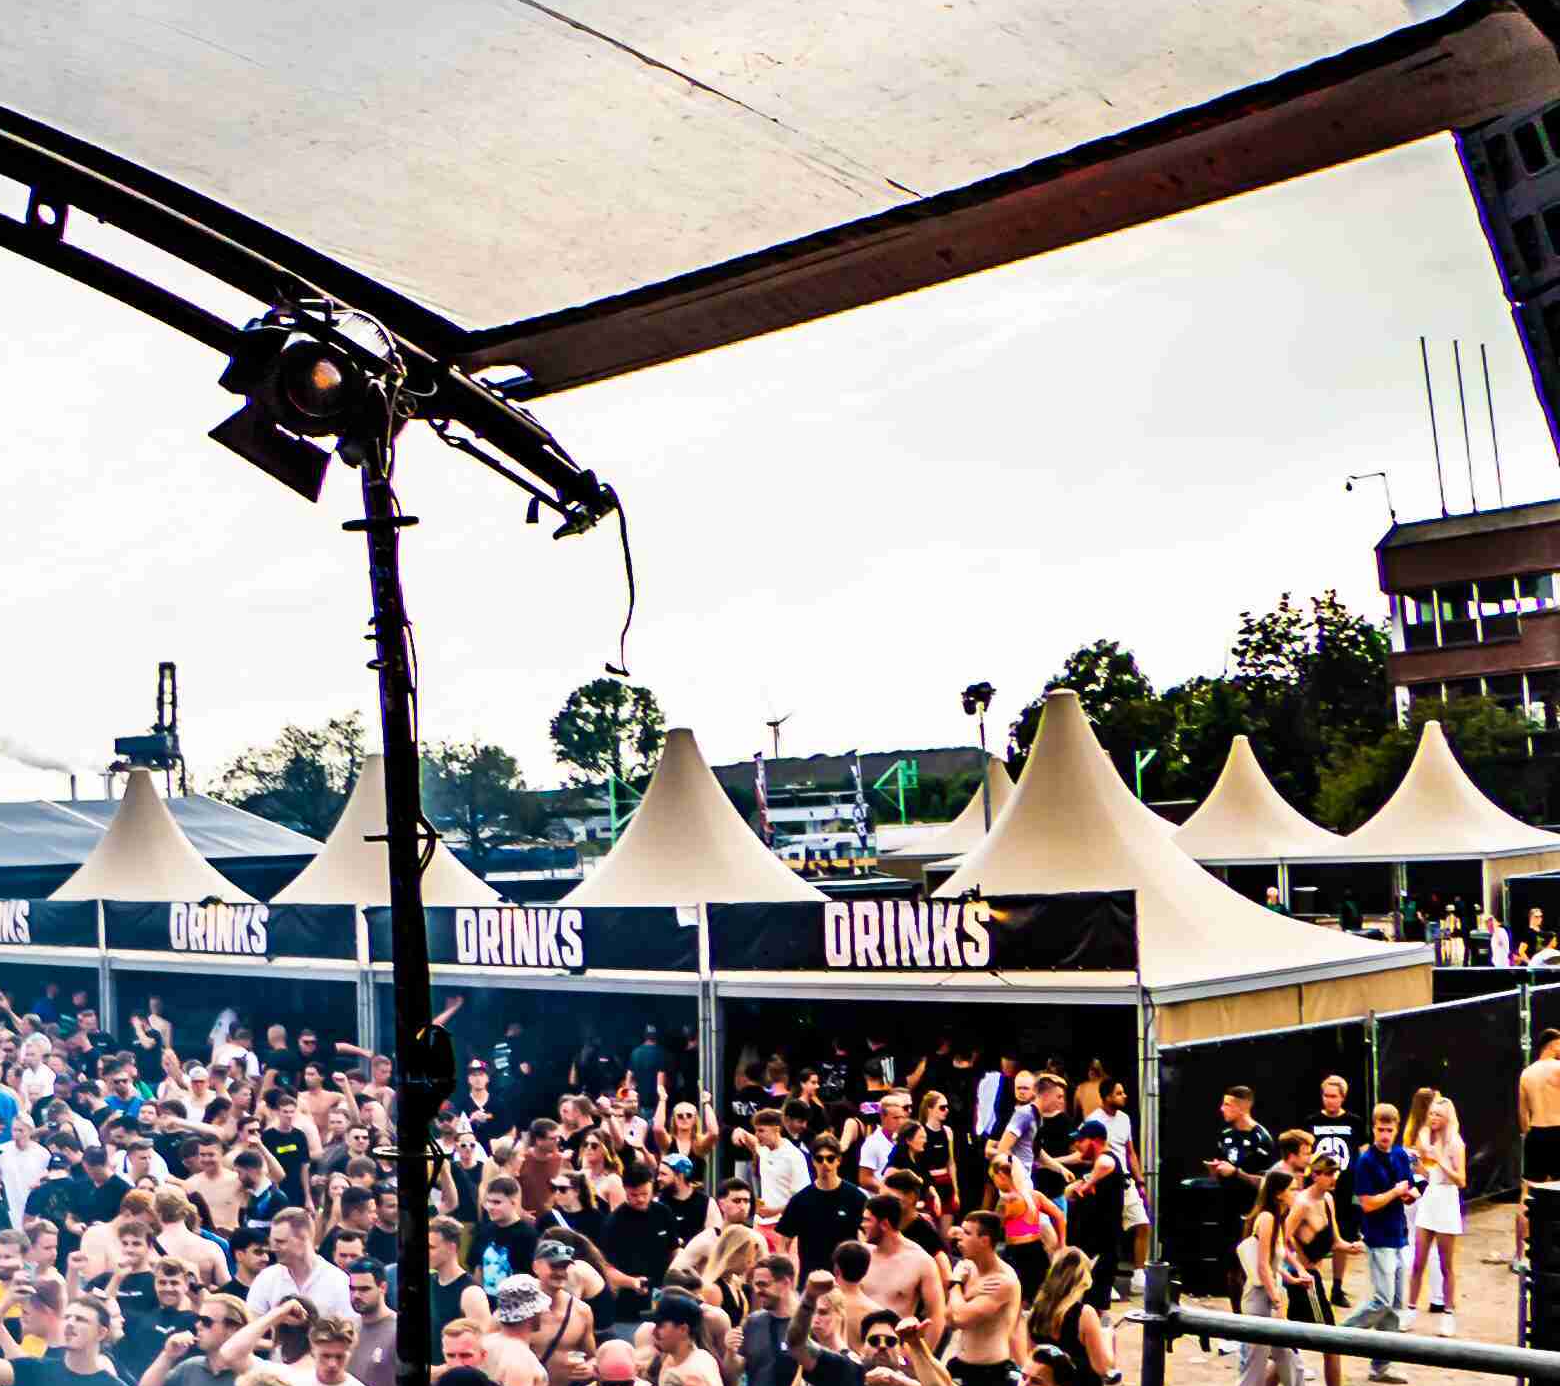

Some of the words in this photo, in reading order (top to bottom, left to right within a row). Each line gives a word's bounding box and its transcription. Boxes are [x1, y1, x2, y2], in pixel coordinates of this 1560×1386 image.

[170, 902, 269, 954] DRINKS
[455, 908, 584, 967] DRINKS
[825, 899, 991, 968] DRINKS
